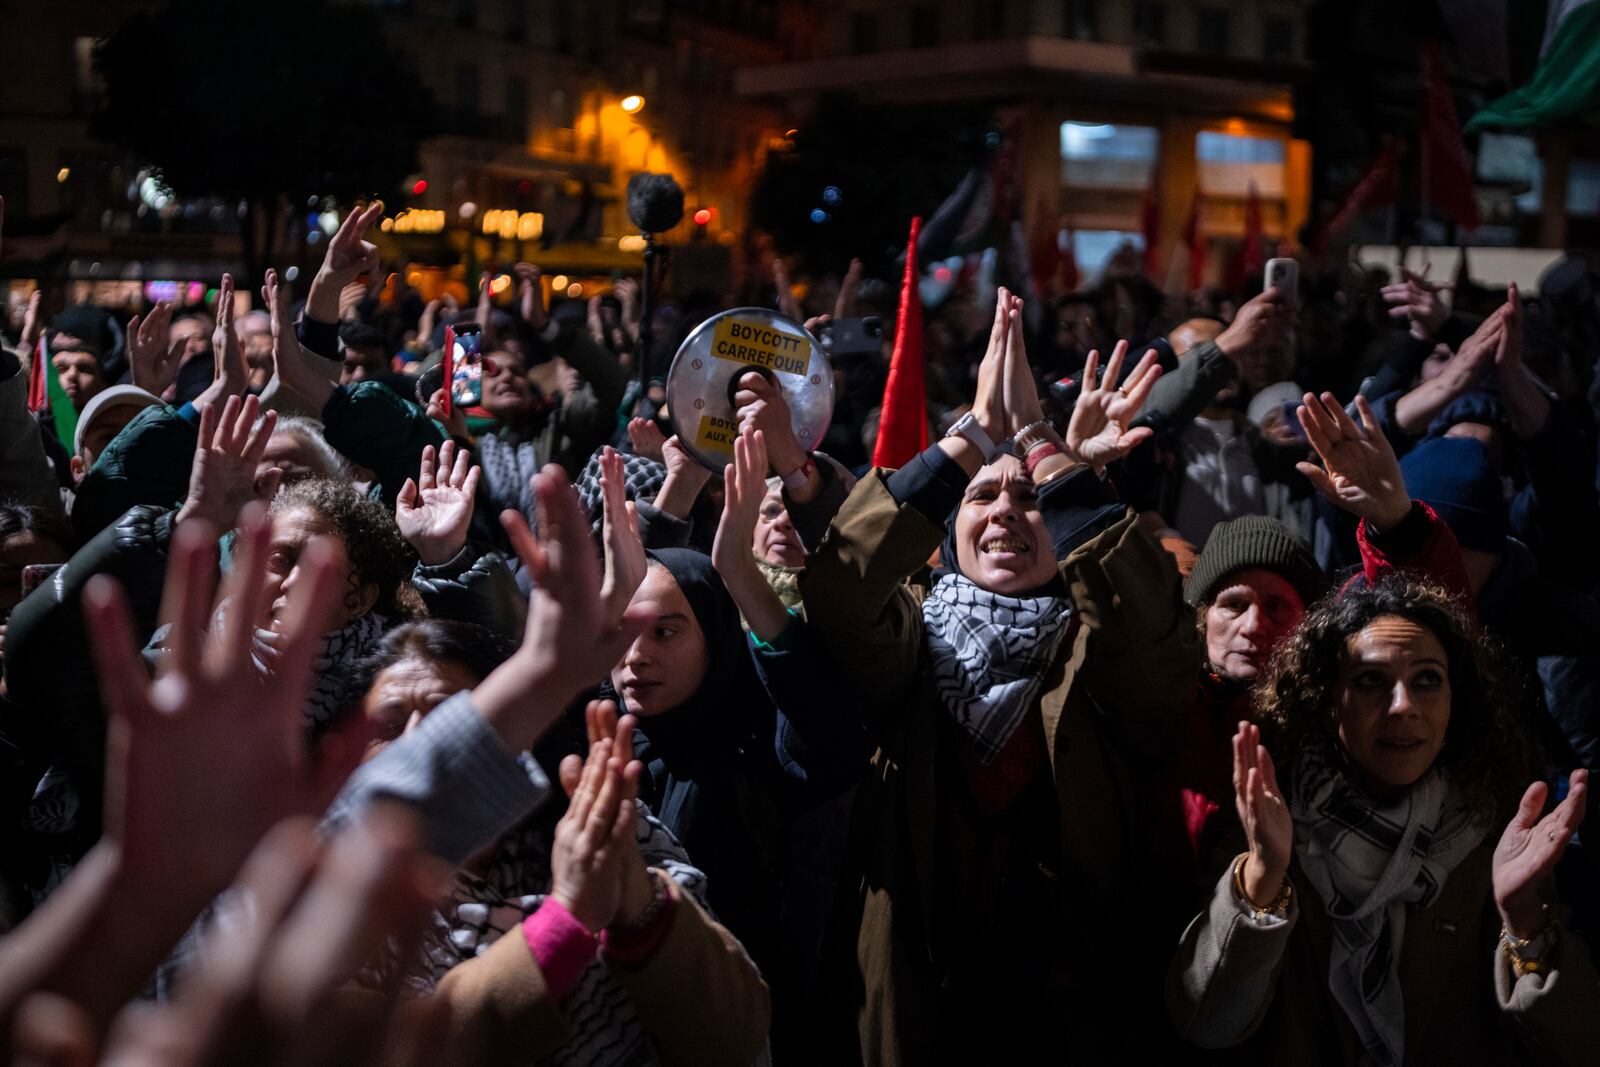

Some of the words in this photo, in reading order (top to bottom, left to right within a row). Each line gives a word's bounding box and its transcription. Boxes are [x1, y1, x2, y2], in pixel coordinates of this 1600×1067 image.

[731, 323, 801, 352] BOYCOTT
[717, 340, 805, 374] CARREFOUR
[705, 430, 727, 443] AUX
